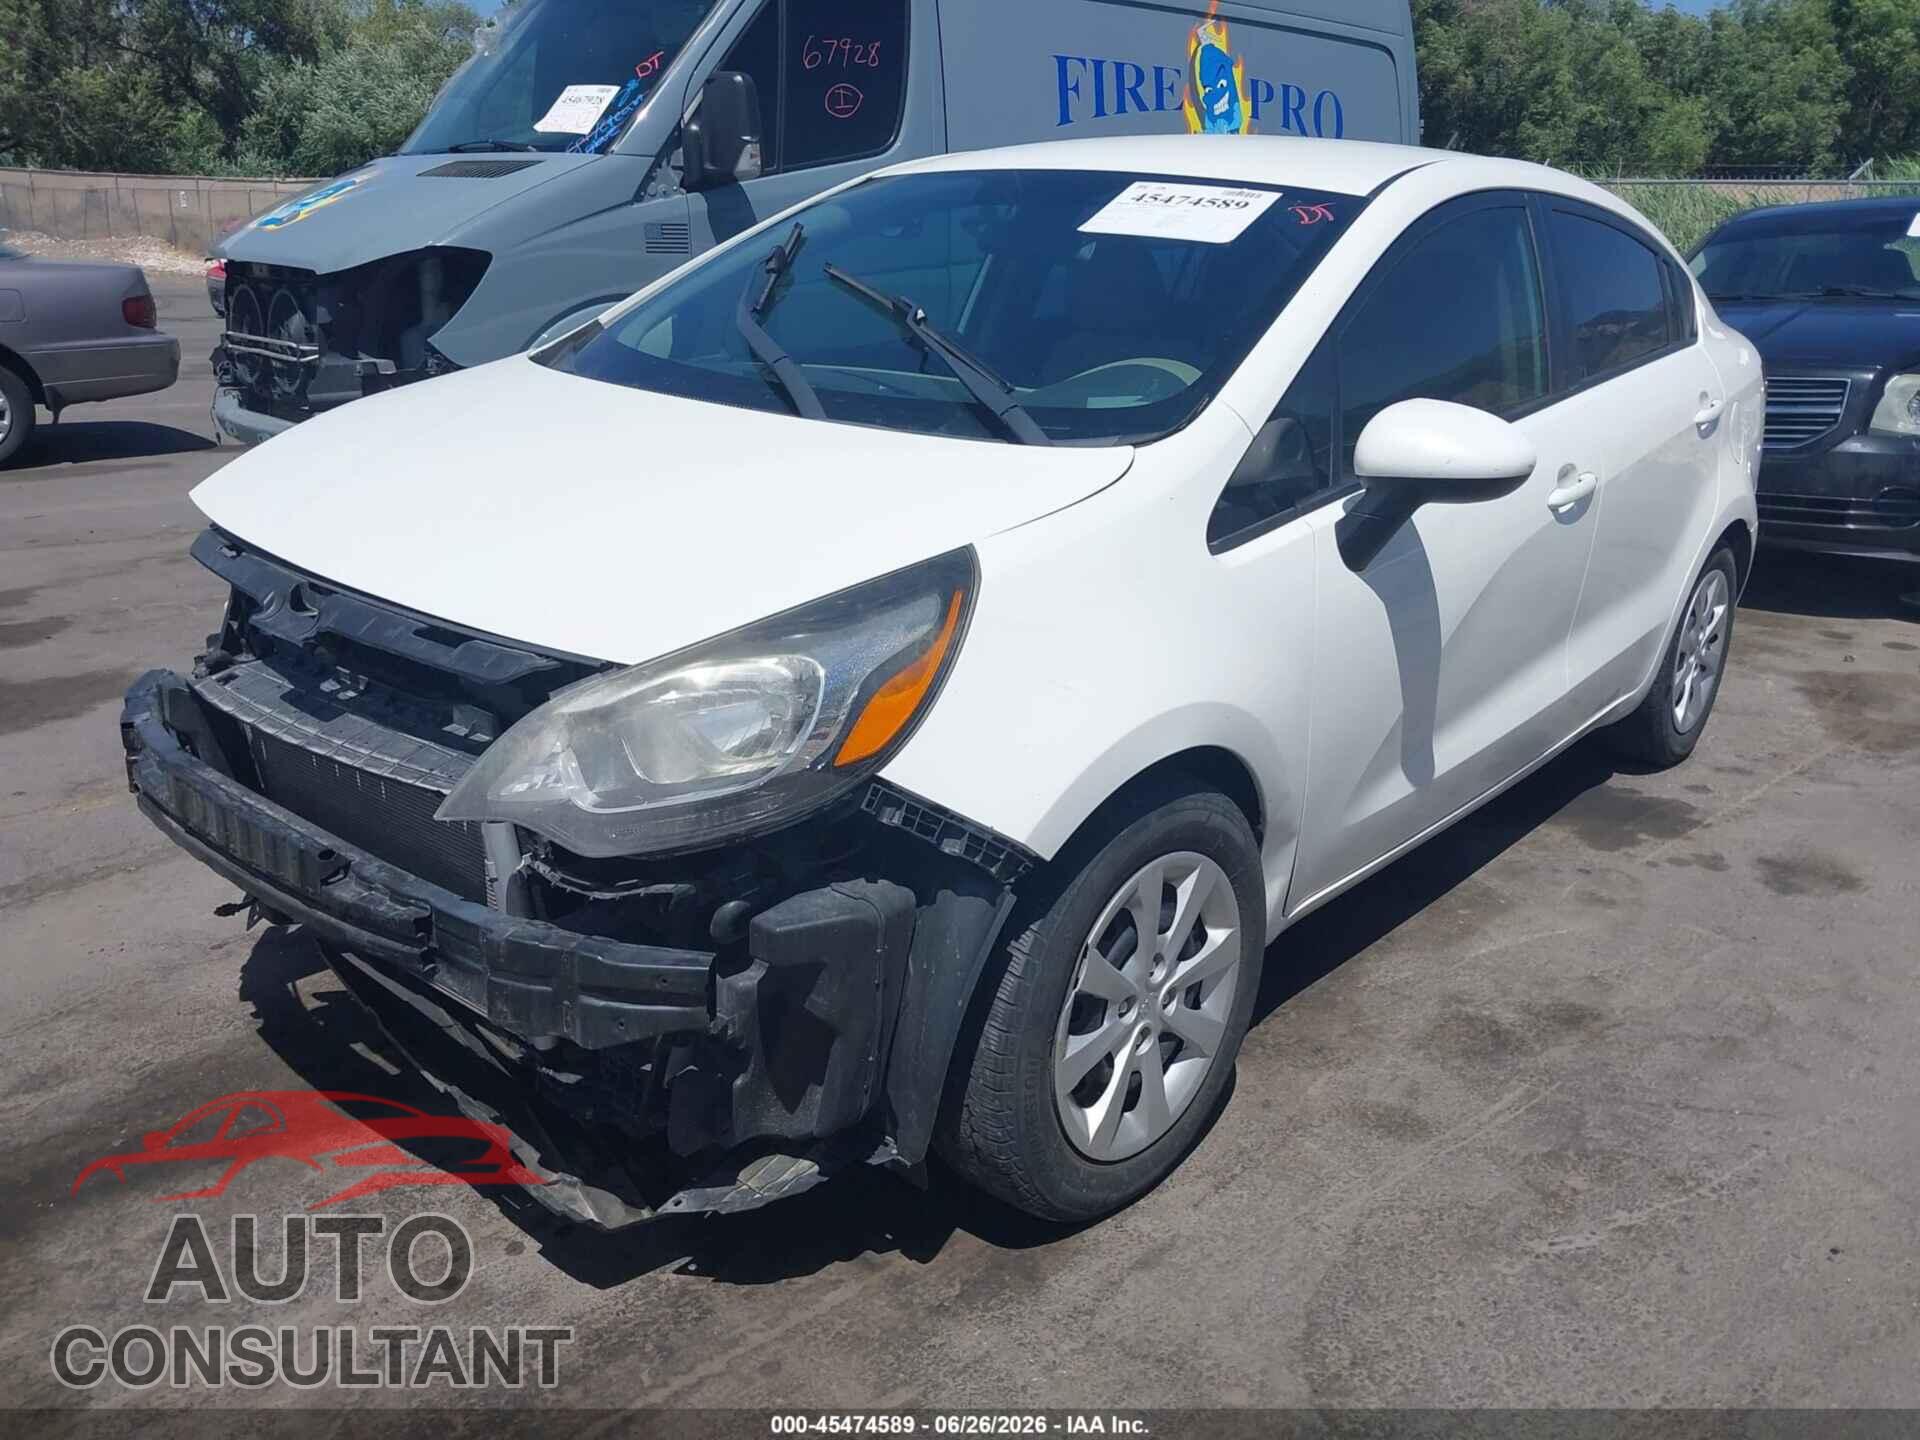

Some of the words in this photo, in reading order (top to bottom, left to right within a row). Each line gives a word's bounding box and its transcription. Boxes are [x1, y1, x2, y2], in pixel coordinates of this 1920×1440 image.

[635, 51, 665, 78] DT
[802, 35, 881, 69] 67928
[1051, 54, 1184, 127] FIRE
[1249, 78, 1344, 139] PRO
[1131, 193, 1250, 209] 45474589
